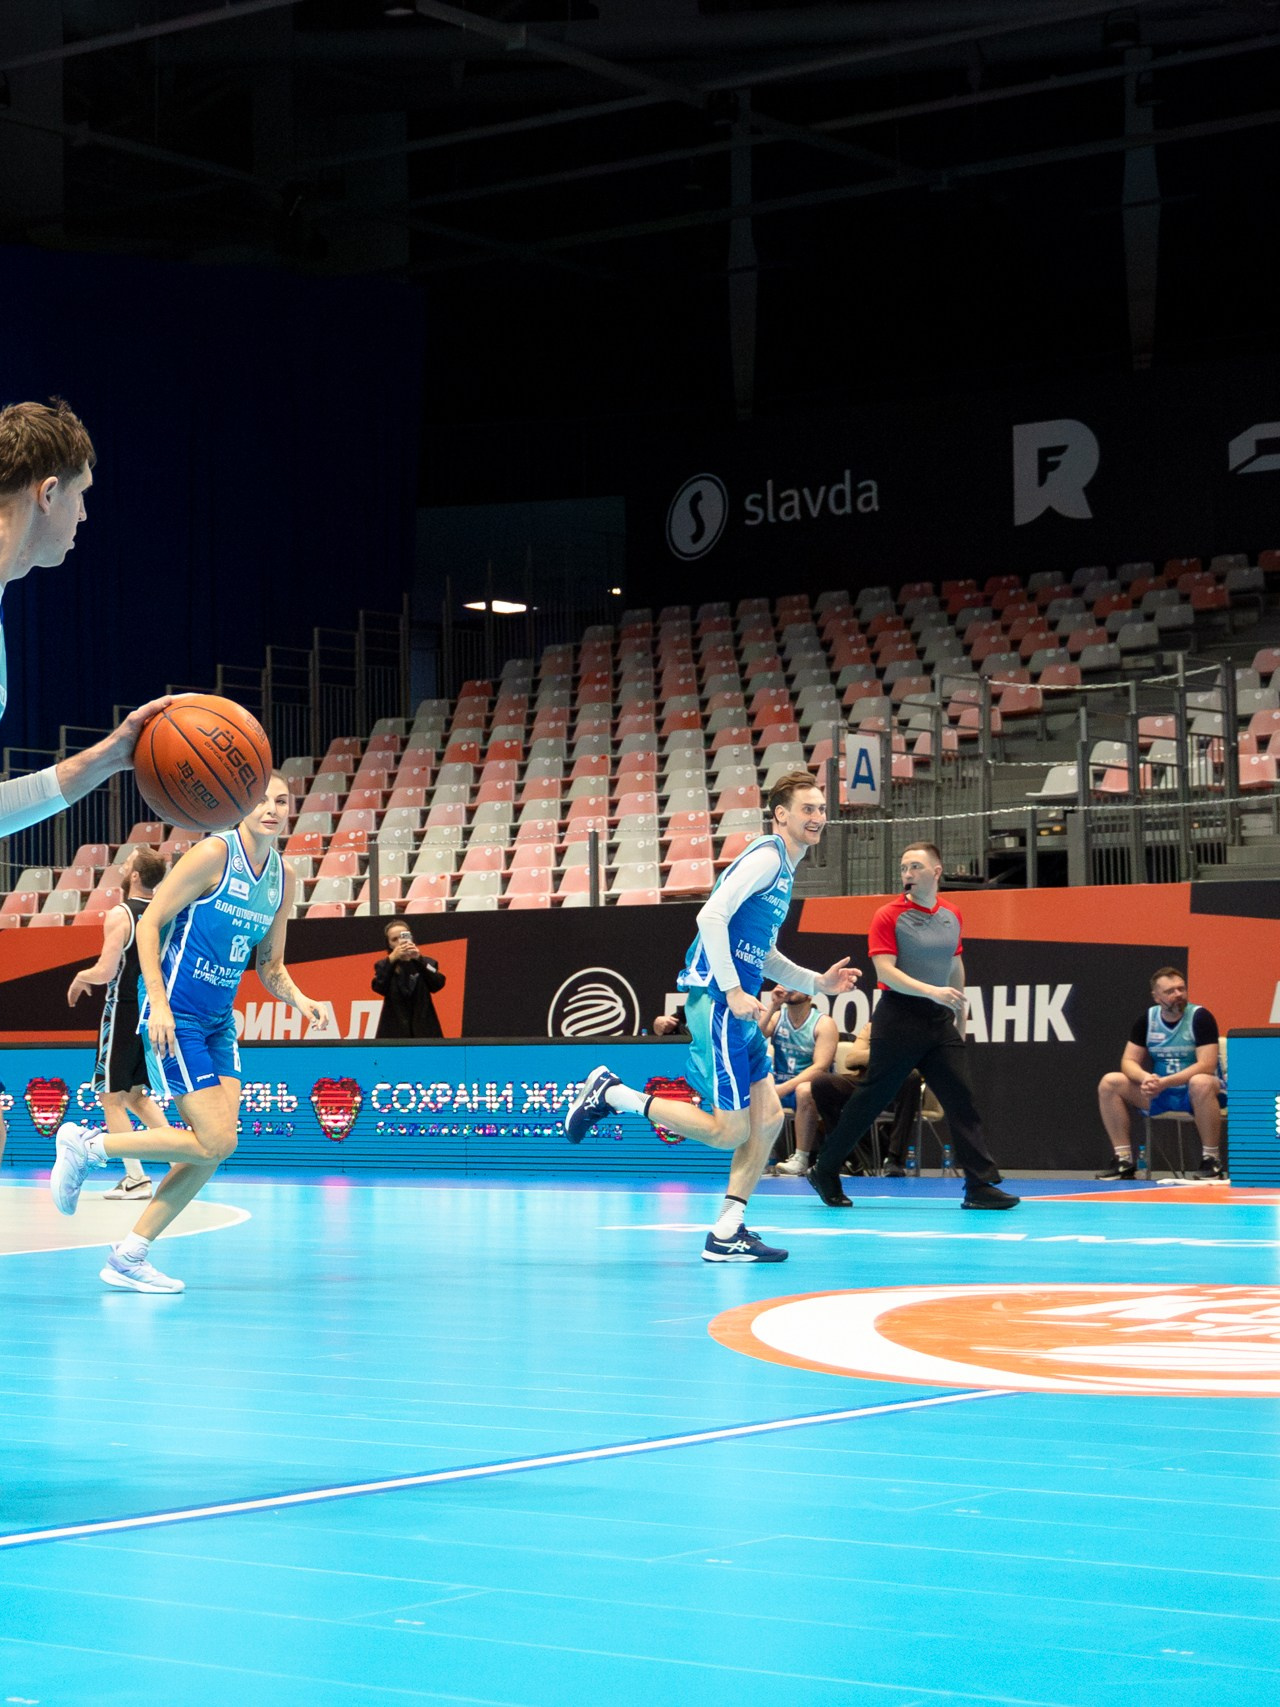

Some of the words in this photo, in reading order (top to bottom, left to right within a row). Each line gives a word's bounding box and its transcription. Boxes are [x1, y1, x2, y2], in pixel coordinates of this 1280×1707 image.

[744, 470, 880, 526] slavda
[196, 726, 258, 799] JÖGEL
[371, 1082, 512, 1113] СОХРАНИ
